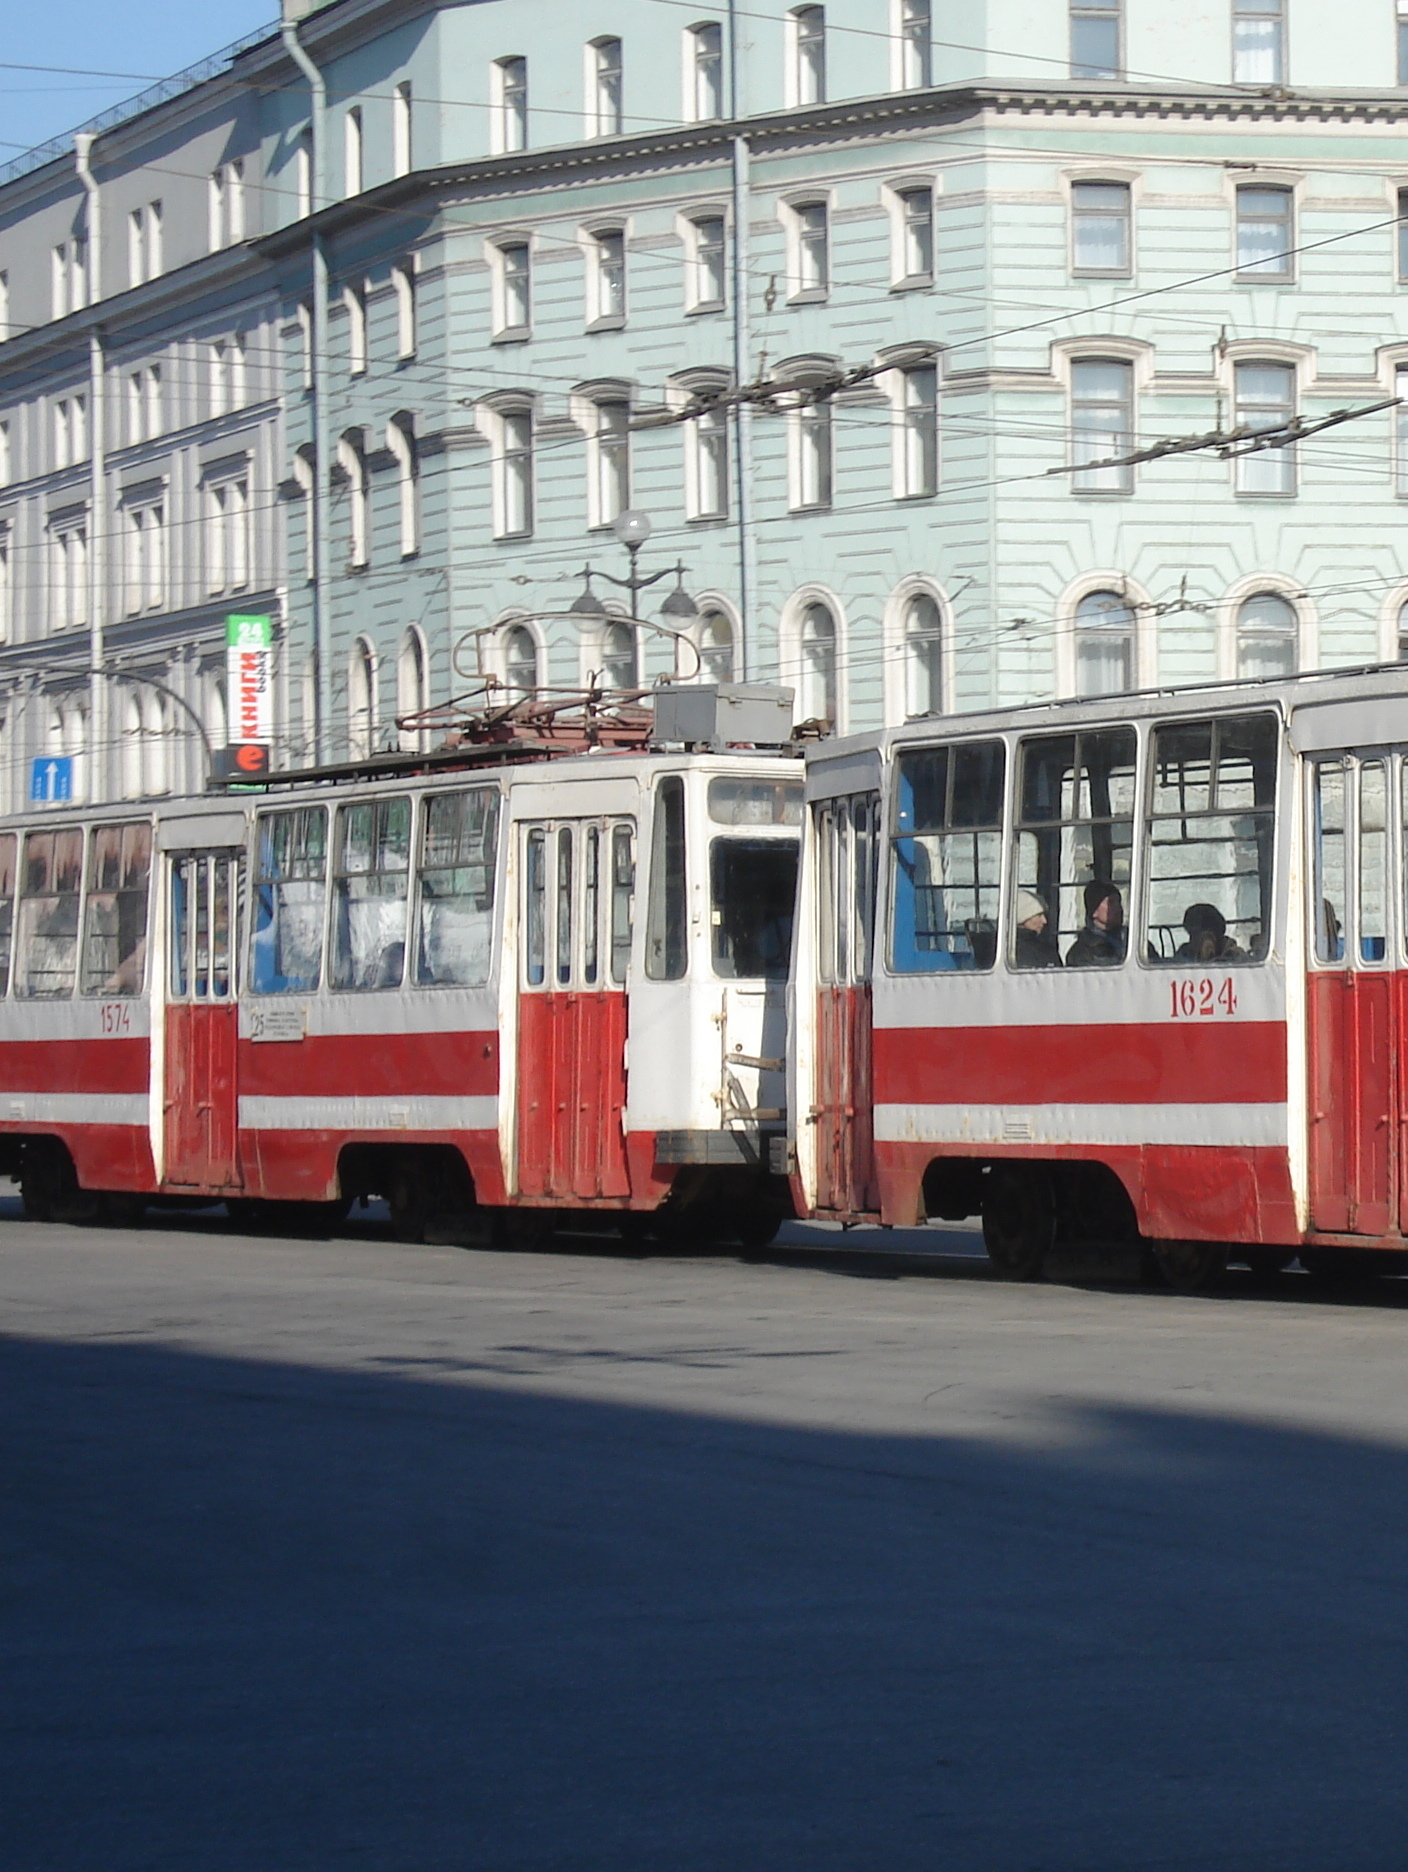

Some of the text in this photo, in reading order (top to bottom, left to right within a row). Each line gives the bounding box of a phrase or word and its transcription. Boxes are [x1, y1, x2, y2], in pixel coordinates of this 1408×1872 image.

[238, 621, 263, 638] 24
[240, 652, 259, 739] КНИГИ
[1170, 977, 1238, 1018] 1624
[100, 1003, 130, 1033] 1574
